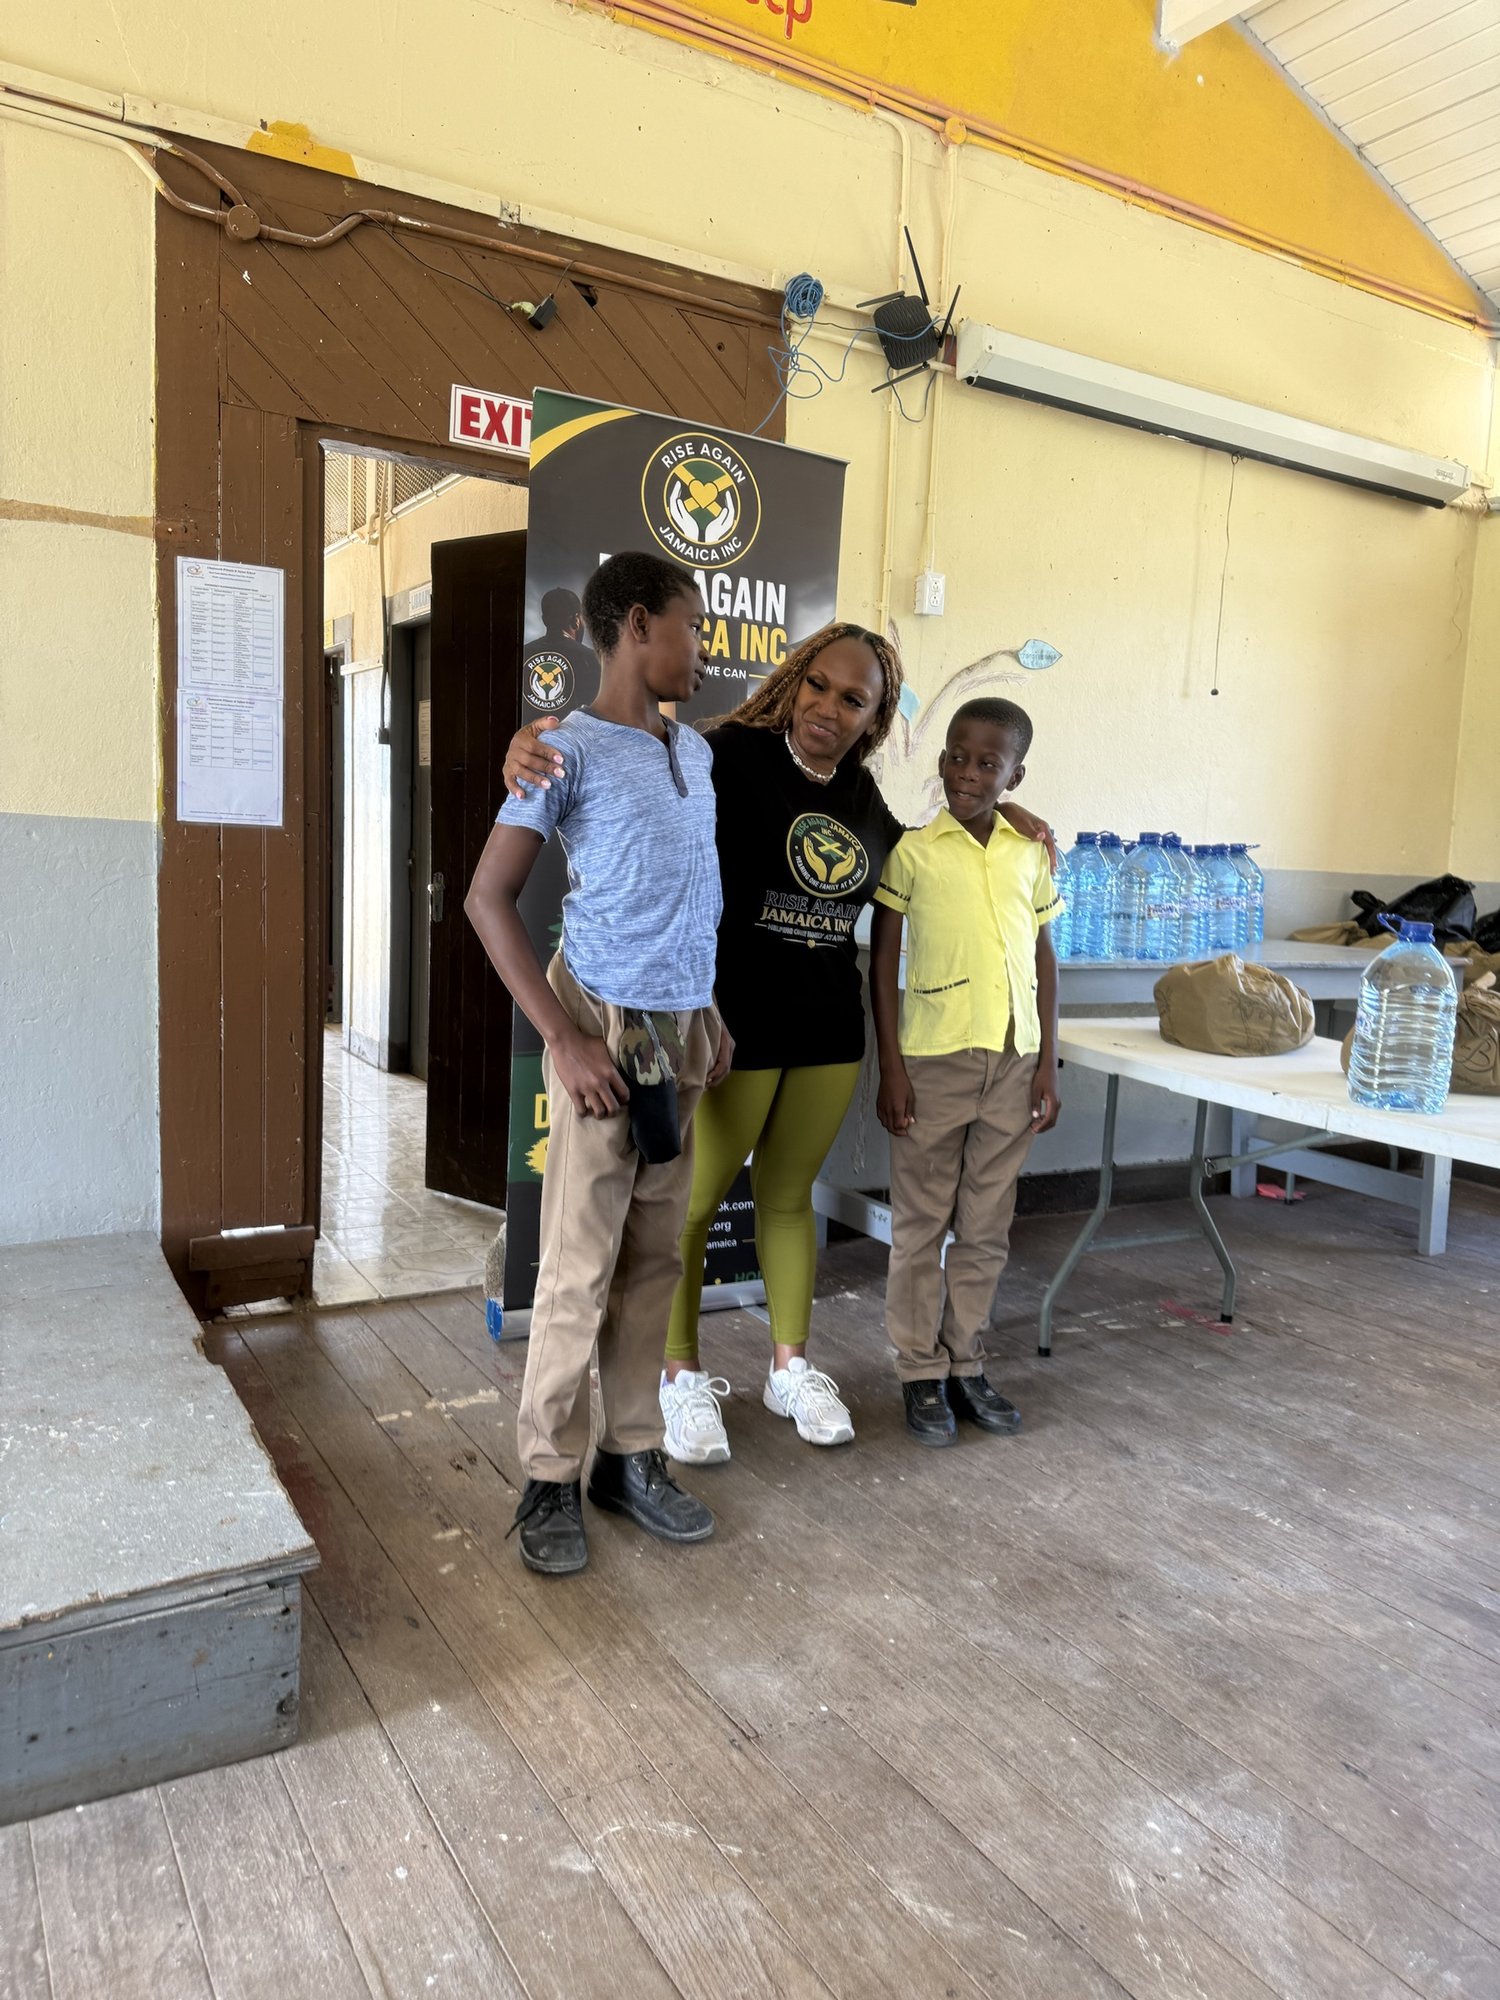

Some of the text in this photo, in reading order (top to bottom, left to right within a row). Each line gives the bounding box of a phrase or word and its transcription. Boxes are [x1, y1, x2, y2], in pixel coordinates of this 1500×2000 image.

[661, 442, 746, 484] RISE AGAIN
[659, 526, 742, 561] JAMAICA INC
[740, 622, 787, 666] INC
[527, 655, 569, 671] RISE AGAIN
[703, 664, 747, 680] WE CAN
[527, 693, 567, 709] JAMAICA INC
[828, 822, 861, 851] JAMAICA
[760, 905, 832, 931] JAMAICA
[763, 889, 861, 920] RISE AGAIN
[706, 1238, 737, 1250] amaica
